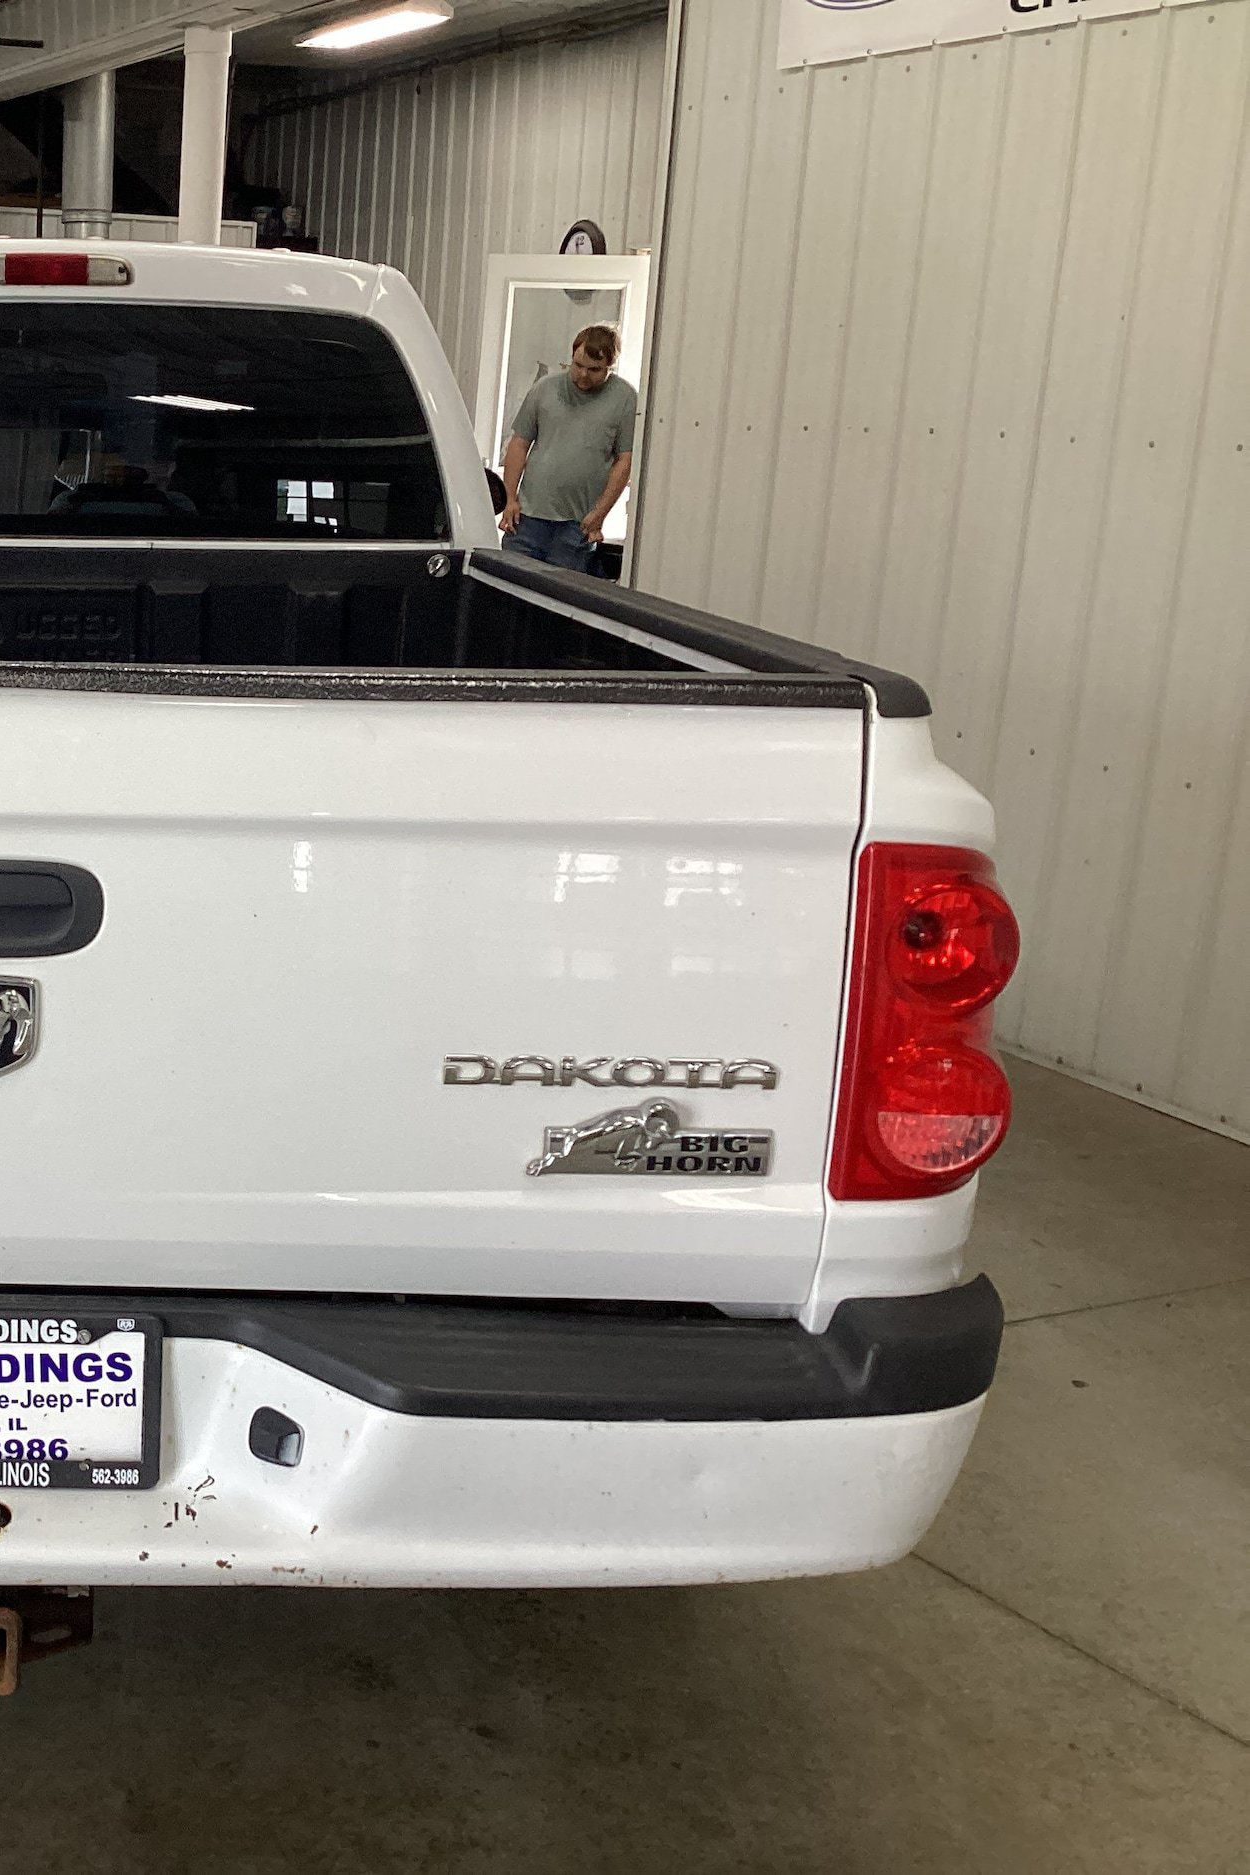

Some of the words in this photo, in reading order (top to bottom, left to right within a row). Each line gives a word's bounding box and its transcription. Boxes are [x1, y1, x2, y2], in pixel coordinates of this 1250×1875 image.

[443, 1053, 777, 1090] DAKOTA
[679, 1136, 750, 1153] BIG
[646, 1156, 763, 1172] HORN
[8, 1418, 28, 1431] IL
[91, 1468, 140, 1485] 562-3986
